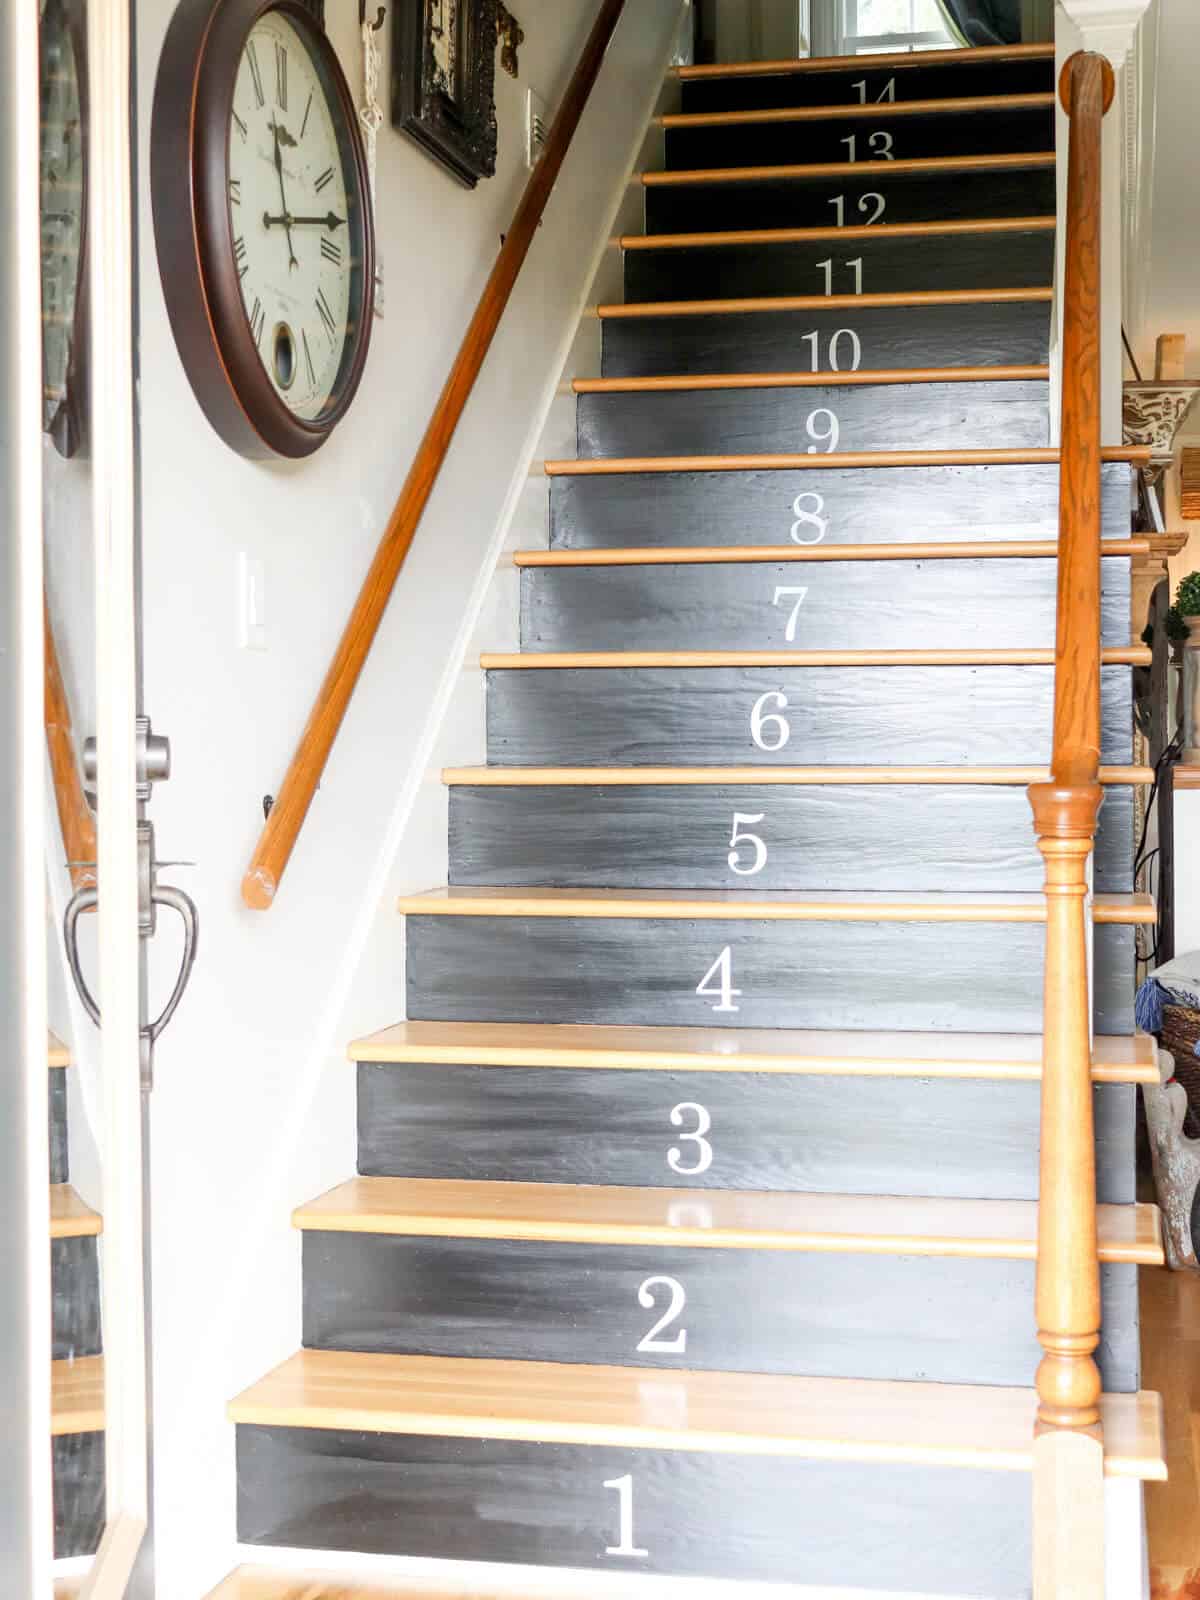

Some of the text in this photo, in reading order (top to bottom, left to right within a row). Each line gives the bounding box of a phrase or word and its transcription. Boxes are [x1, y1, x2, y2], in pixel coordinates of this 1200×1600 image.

[851, 77, 896, 105] 14
[840, 131, 895, 163] 13
[828, 192, 886, 227] 12
[815, 257, 863, 296] 11
[801, 328, 862, 372] 10
[806, 408, 840, 454] 9
[791, 492, 826, 545] 8
[772, 586, 809, 642] 7
[750, 691, 790, 751] 6
[727, 812, 768, 876] 5
[695, 945, 742, 1012] 4
[666, 1102, 713, 1175] 3
[635, 1275, 687, 1354] 2
[602, 1473, 649, 1558] 1
